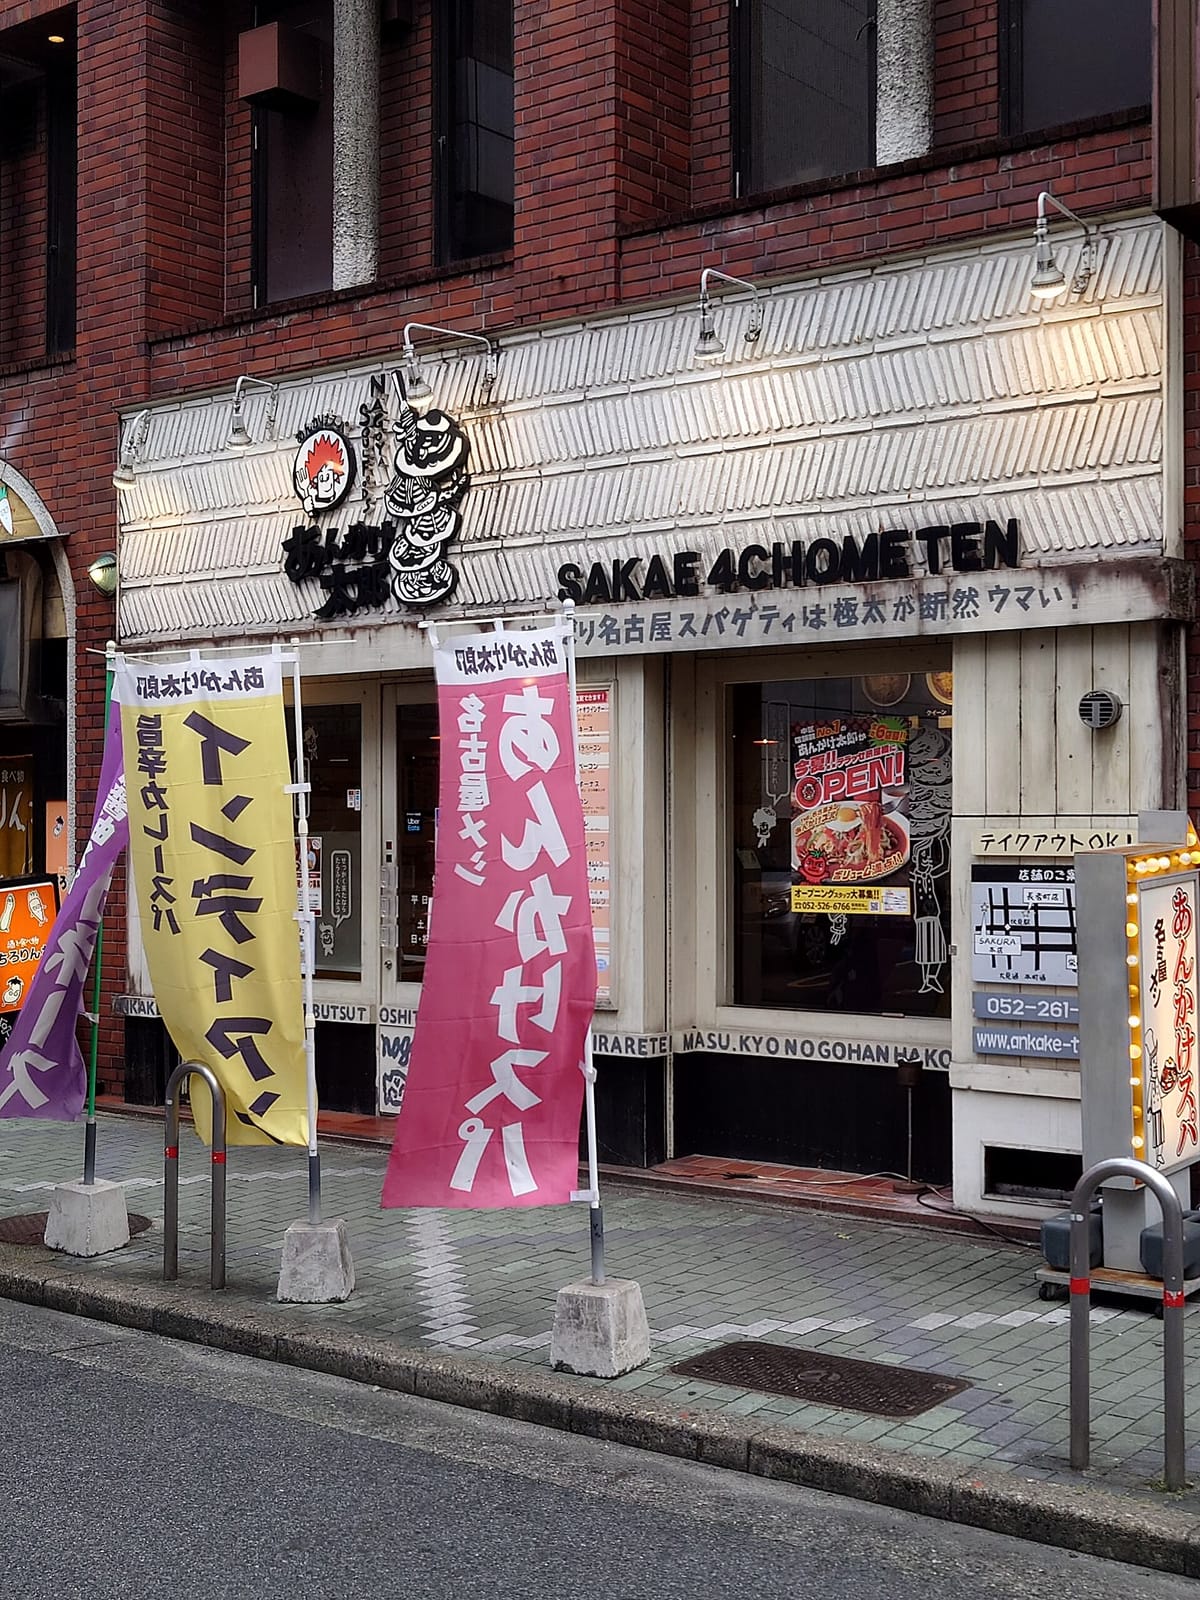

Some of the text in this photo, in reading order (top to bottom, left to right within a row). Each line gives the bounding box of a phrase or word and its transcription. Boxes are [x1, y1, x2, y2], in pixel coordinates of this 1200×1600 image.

[558, 551, 702, 604] SAKAE
[916, 518, 1020, 575] TEN
[794, 750, 905, 808] OPEN!
[1172, 886, 1199, 1157] あんかけスパ
